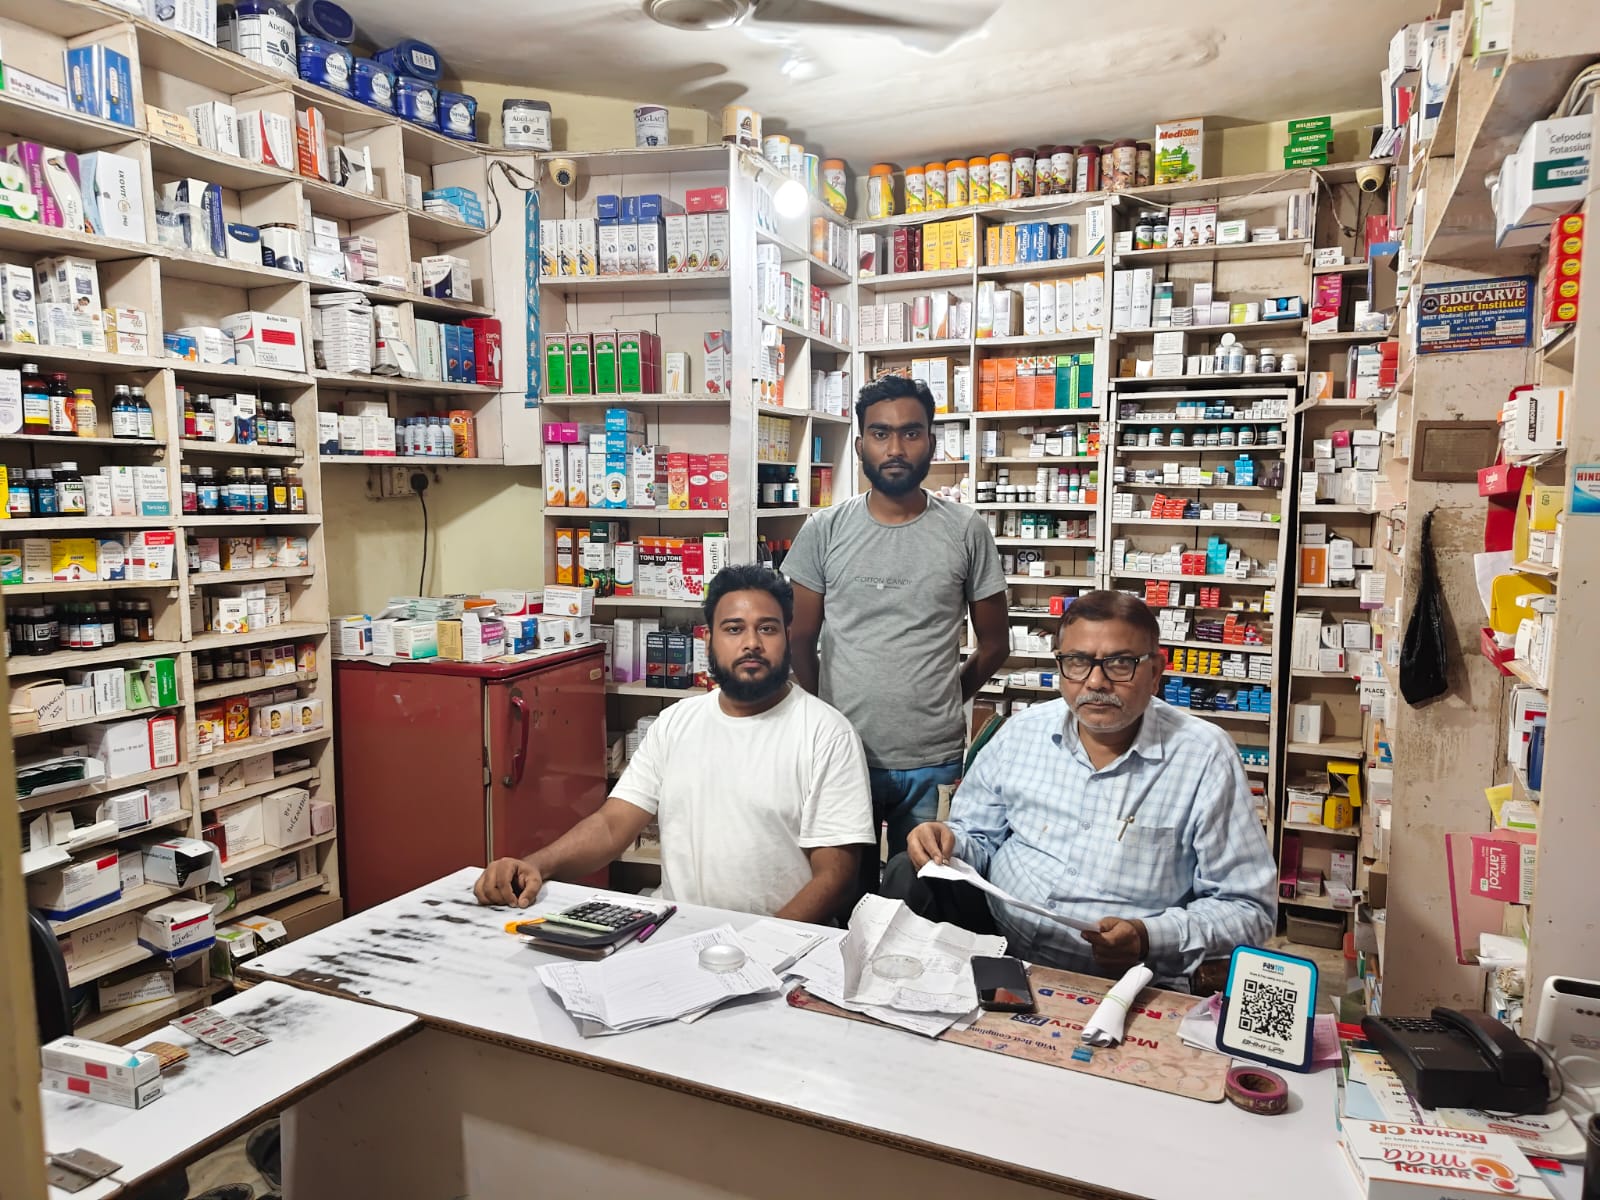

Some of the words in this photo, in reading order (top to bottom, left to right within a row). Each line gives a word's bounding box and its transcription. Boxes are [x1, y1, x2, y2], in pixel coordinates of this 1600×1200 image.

[1159, 129, 1199, 140] MediSlim
[1037, 225, 1045, 258] Calcimax
[1056, 227, 1064, 259] Calcimax
[1439, 287, 1526, 305] EDUCARVE
[1439, 303, 1475, 313] Career
[1478, 299, 1526, 310] Institute
[1489, 847, 1502, 890] Lanzol
[968, 1025, 1013, 1041] Complime
[1015, 1035, 1033, 1046] Best
[1037, 1040, 1057, 1051] With
[1369, 1123, 1406, 1136] CR
